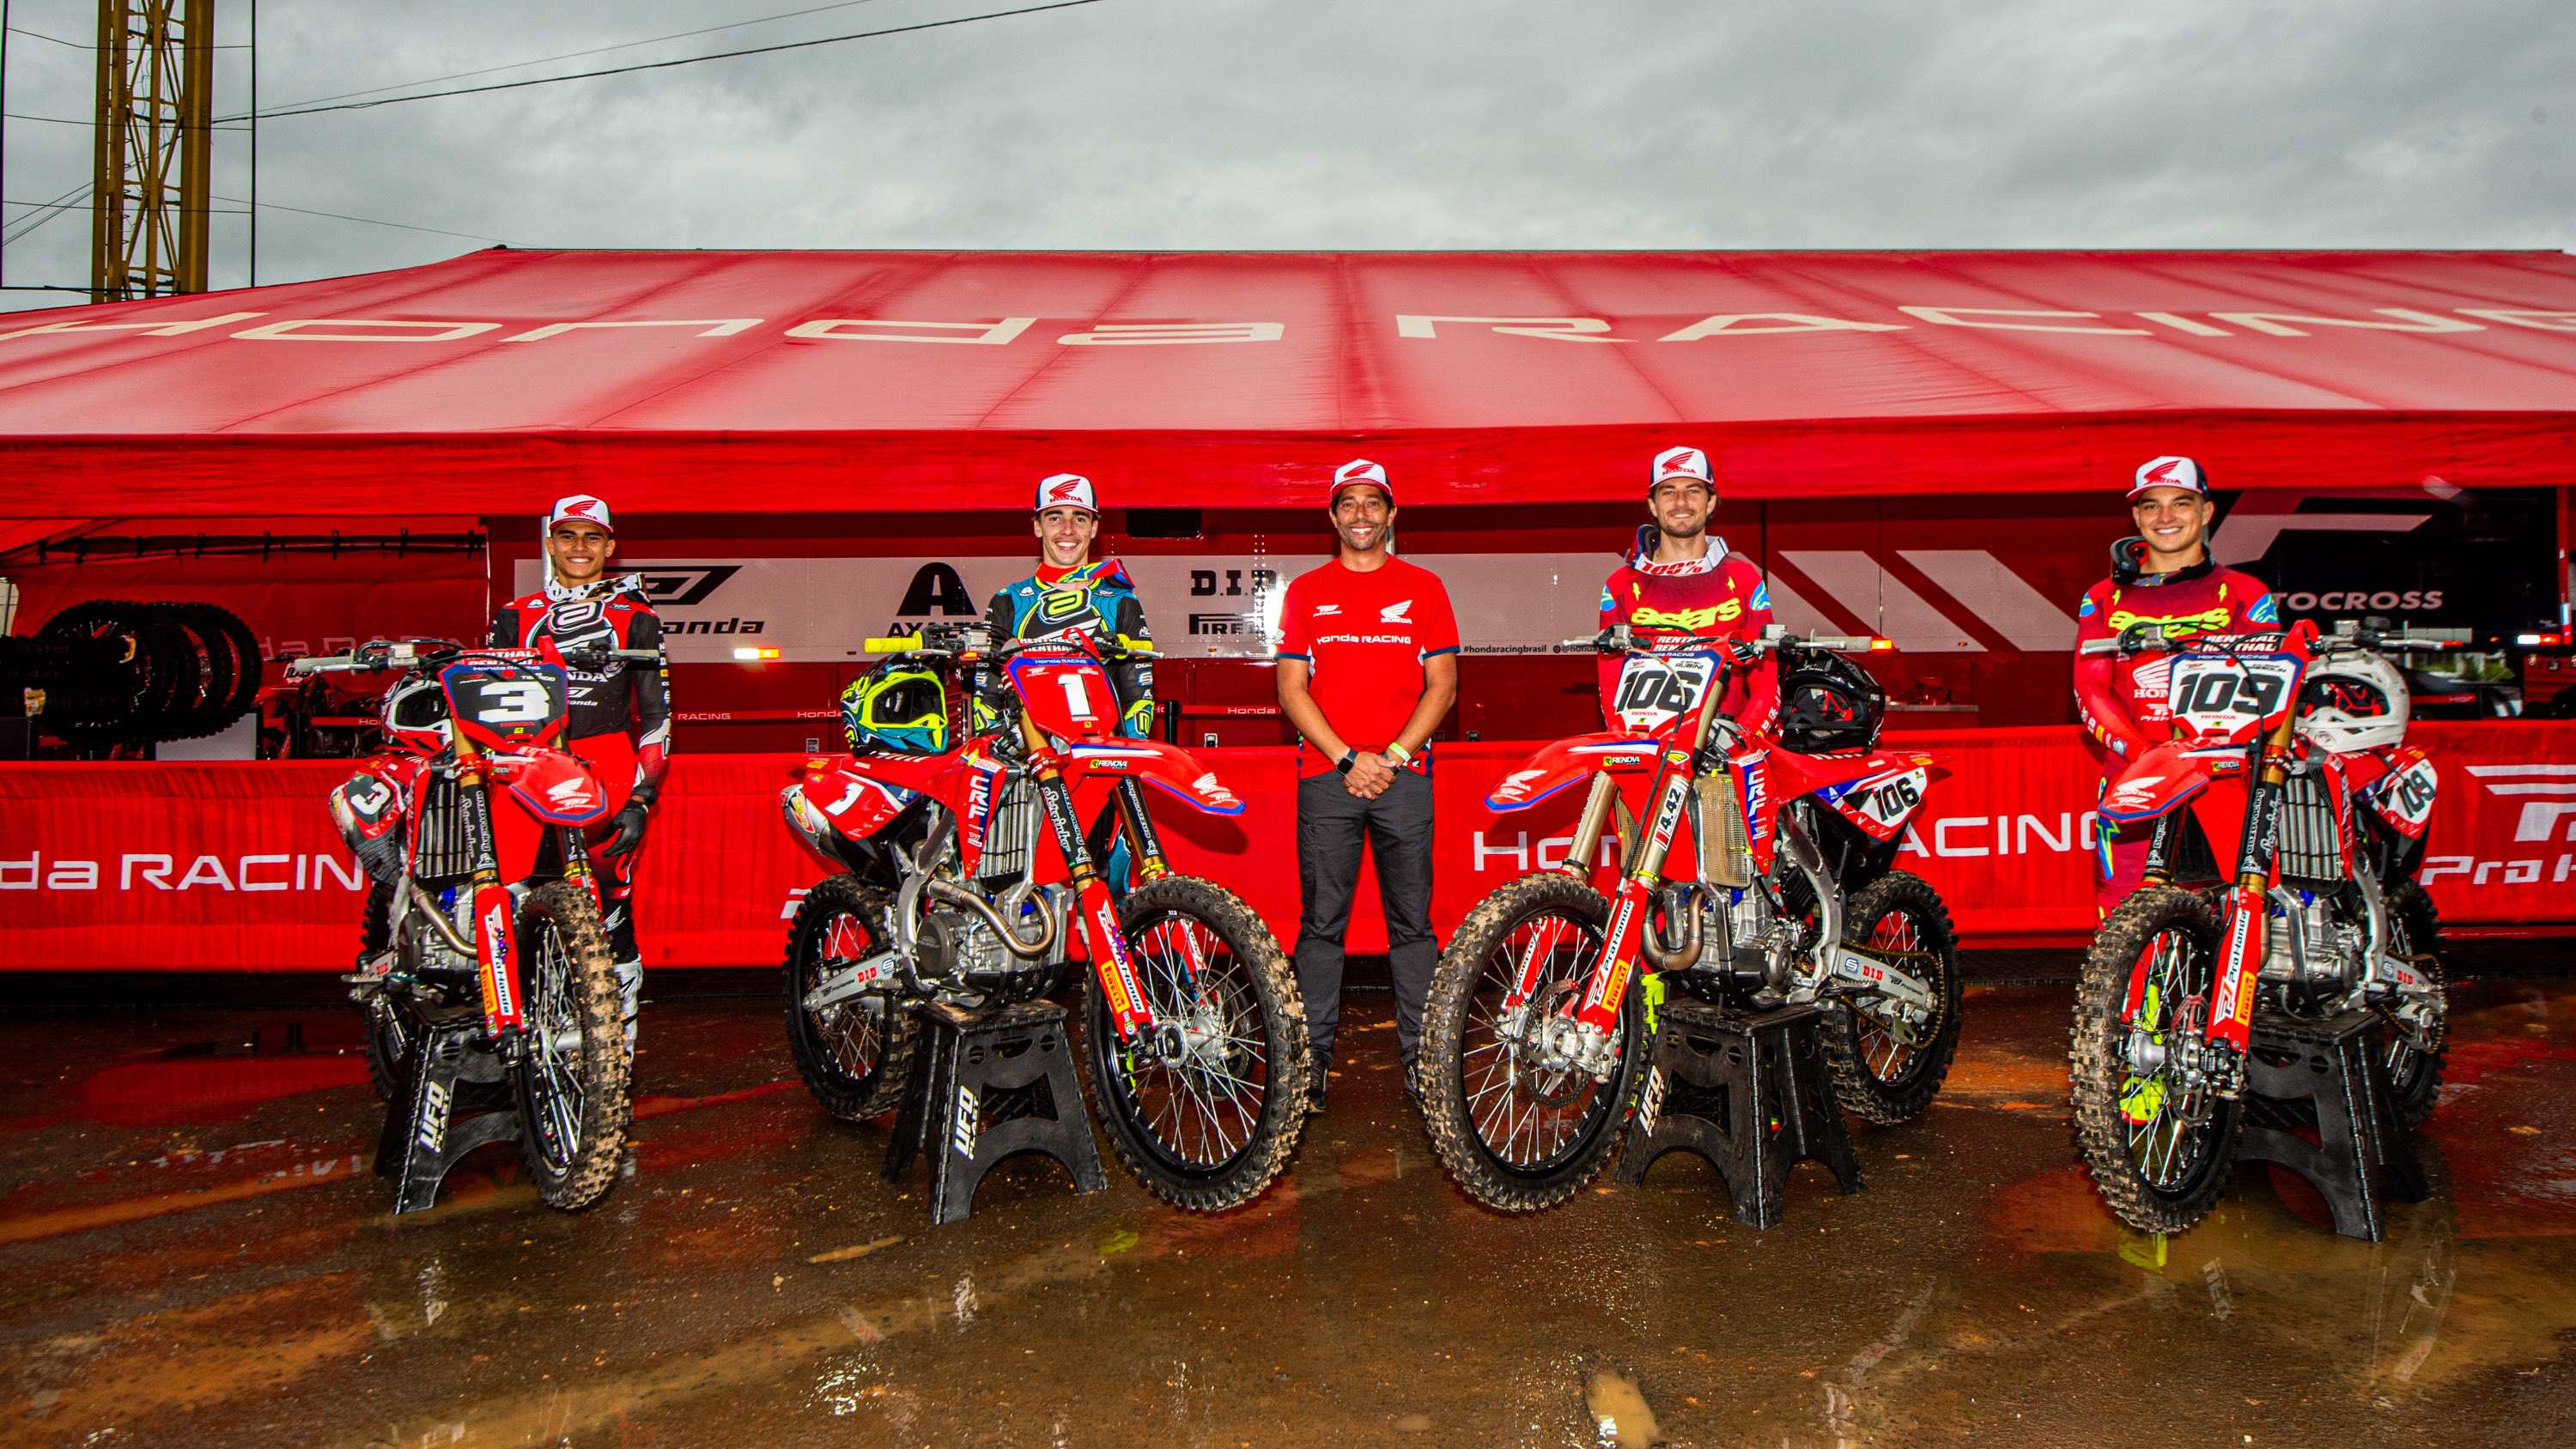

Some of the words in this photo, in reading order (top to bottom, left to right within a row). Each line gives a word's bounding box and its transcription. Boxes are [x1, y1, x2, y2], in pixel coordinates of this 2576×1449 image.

[0, 312, 1285, 345] Honda
[1642, 560, 1704, 575] 100%
[1631, 598, 1741, 632] astars
[1316, 634, 1358, 645] Honda
[1361, 634, 1412, 644] RACING
[1463, 645, 1547, 654] #hondaracingbrasil
[477, 681, 550, 723] 3
[1057, 674, 1093, 716] 1
[1616, 670, 1704, 713] 106
[2174, 673, 2286, 716] 109
[969, 775, 990, 819] CRF
[1060, 783, 1084, 846] enzoracing
[1658, 787, 1683, 831] 4.42
[1748, 769, 1767, 818] CRF
[1873, 777, 1920, 822] 106
[2246, 788, 2266, 854] enzoracing
[120, 854, 364, 891] RACIN
[1104, 966, 1126, 1007] PIRELLI
[1607, 963, 1627, 1008] PIRELLI
[2239, 978, 2254, 1022] PIRELLI
[419, 1080, 446, 1150] UFO
[954, 1085, 975, 1158] UFO
[1638, 1065, 1662, 1135] UFO
